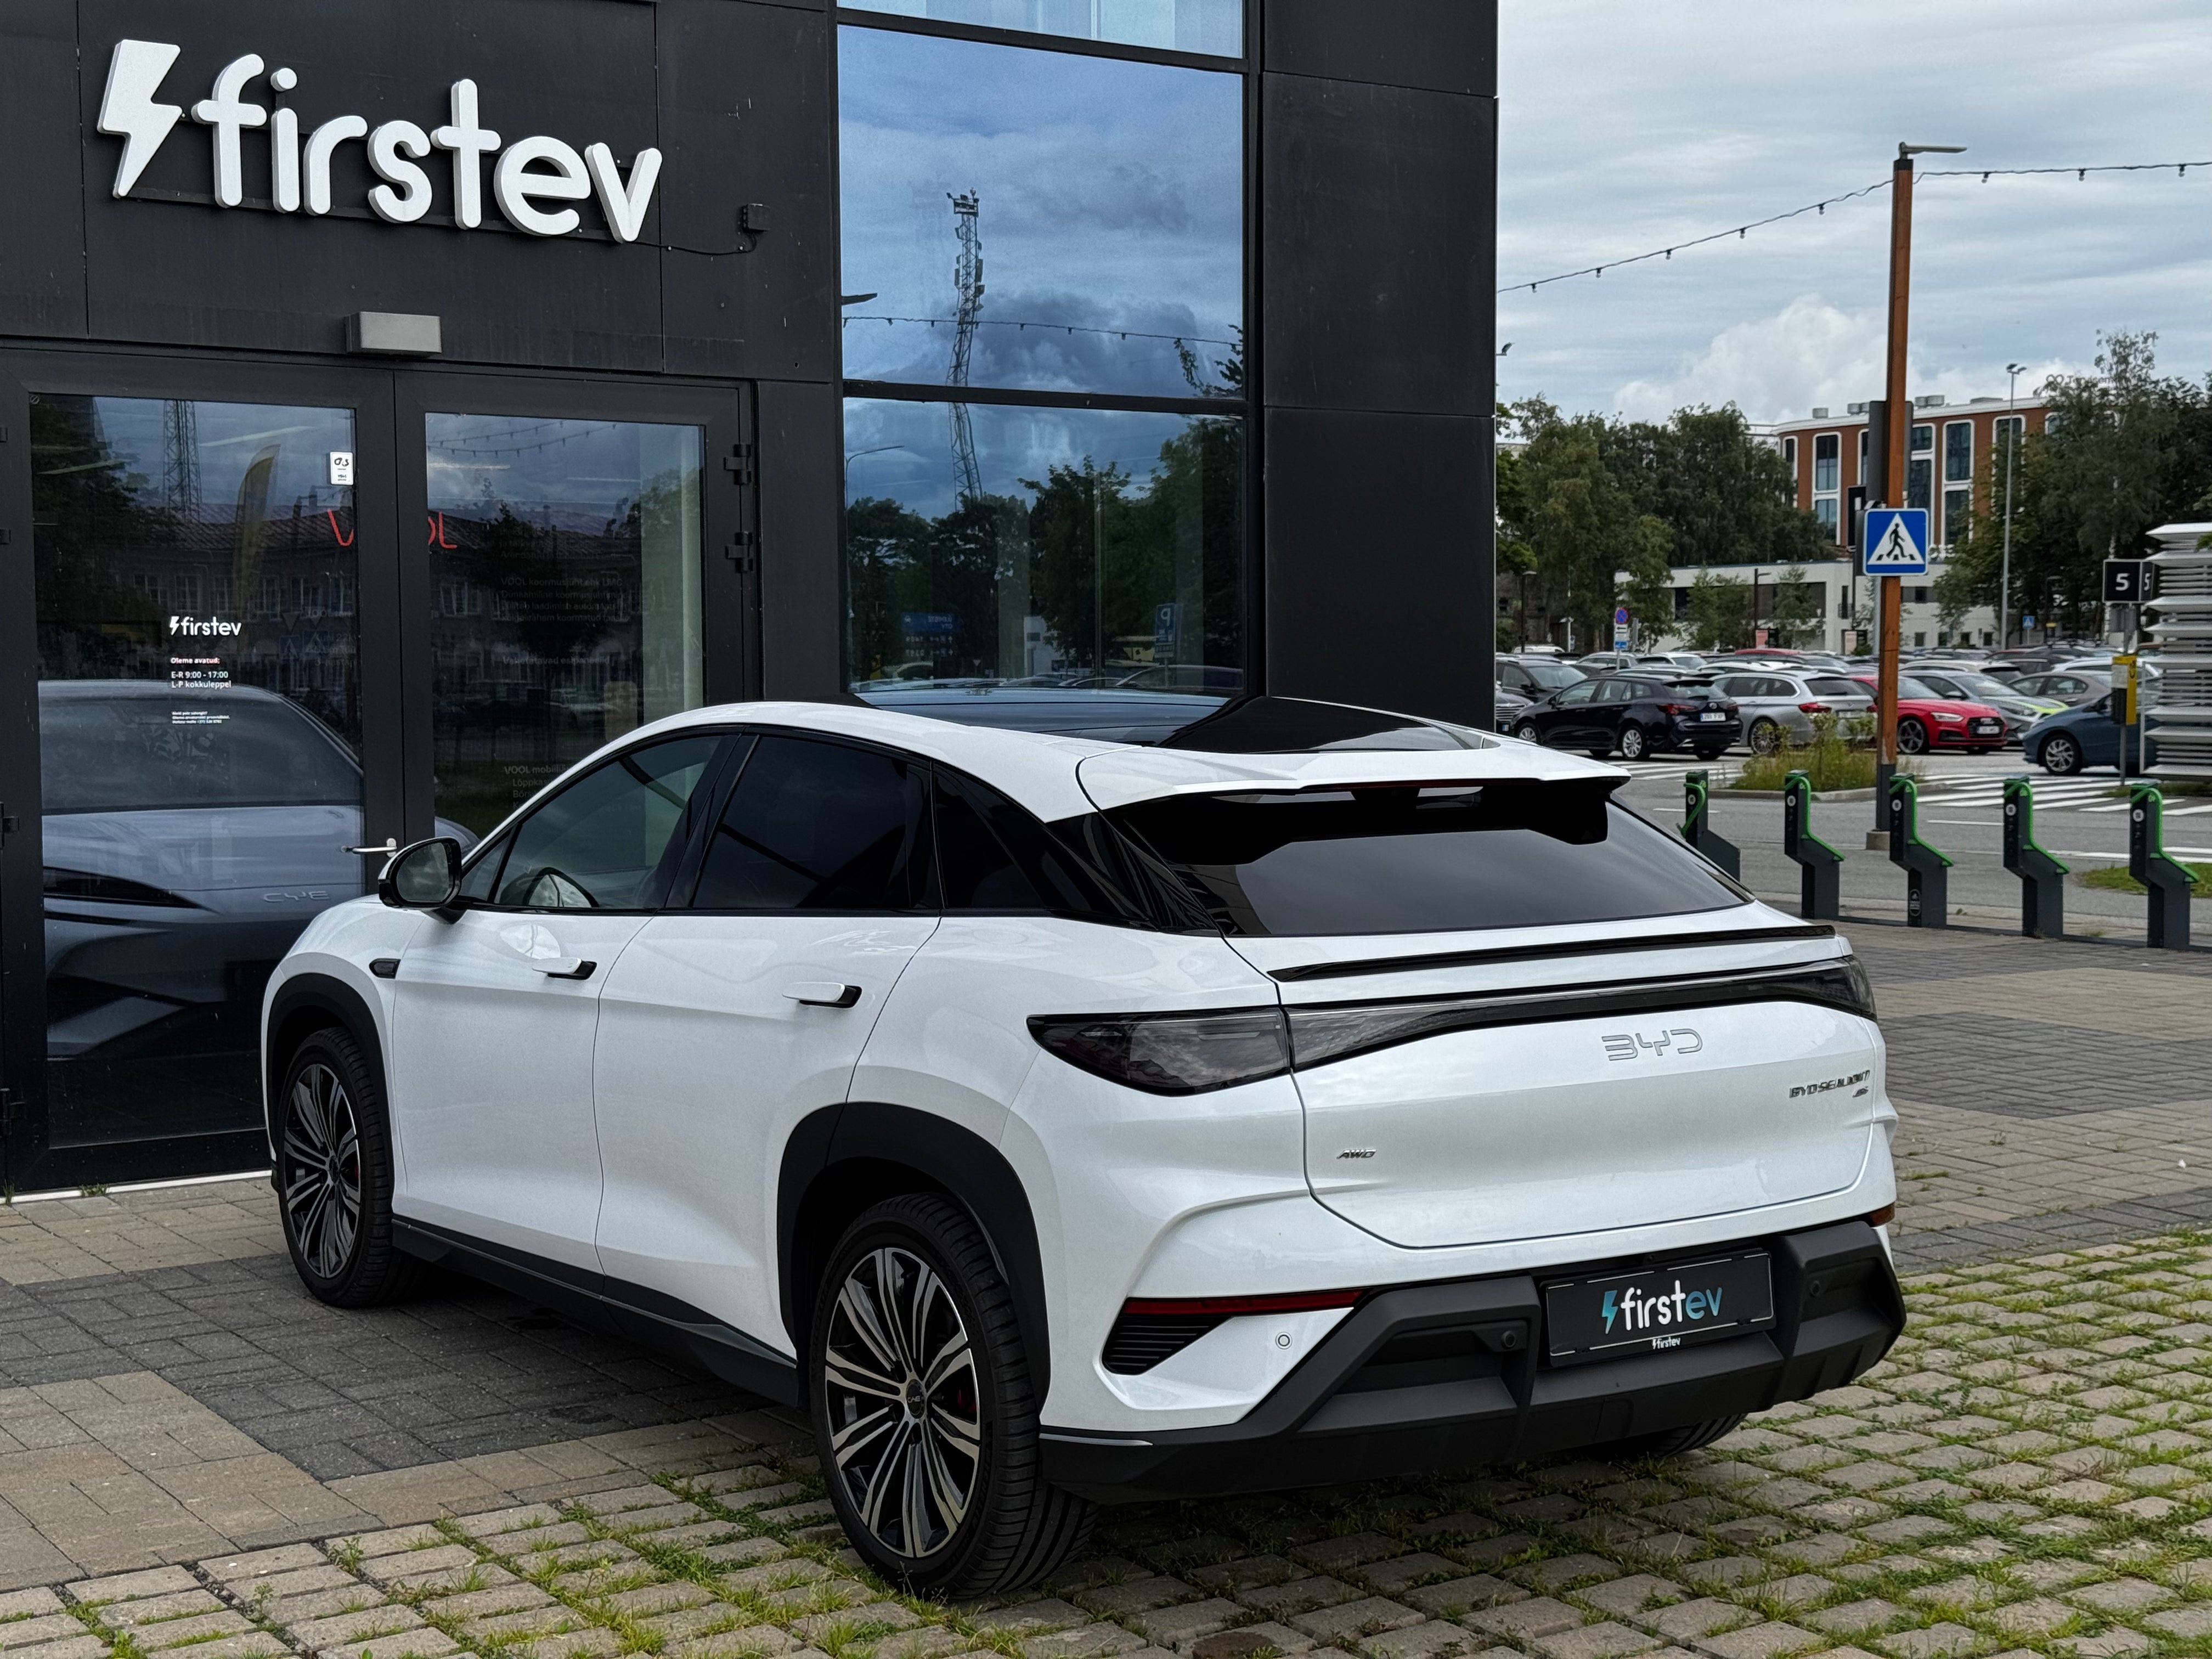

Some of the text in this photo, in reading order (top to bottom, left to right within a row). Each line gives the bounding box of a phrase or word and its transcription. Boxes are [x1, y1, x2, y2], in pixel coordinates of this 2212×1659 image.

[191, 53, 663, 244] firstev
[2115, 573, 2130, 591] 5
[2143, 573, 2152, 591] 5
[180, 616, 242, 636] firstev
[185, 680, 232, 690] kokkuleppel
[504, 765, 531, 775] VOOL
[1601, 1028, 1703, 1062] BYD
[1336, 1149, 1377, 1159] AWD
[1620, 1279, 1723, 1331] firstev
[1657, 1336, 1681, 1349] firstev
